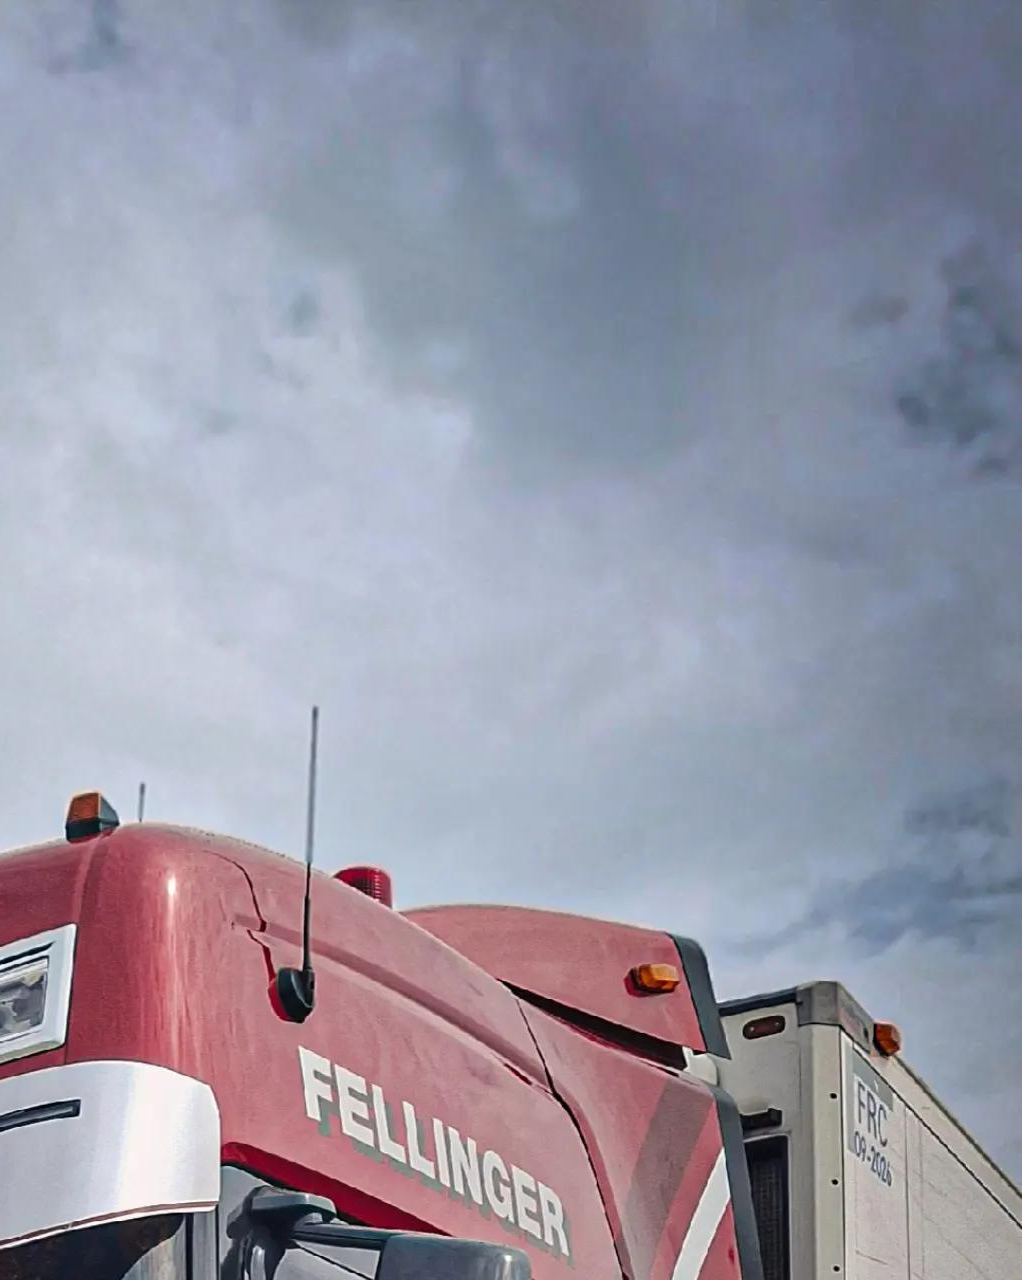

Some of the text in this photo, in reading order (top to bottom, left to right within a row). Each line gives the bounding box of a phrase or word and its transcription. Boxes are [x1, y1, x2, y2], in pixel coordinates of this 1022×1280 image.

[857, 1081, 888, 1147] FRC
[297, 1046, 571, 1258] FELLINGER
[854, 1130, 892, 1187] 09-2026
